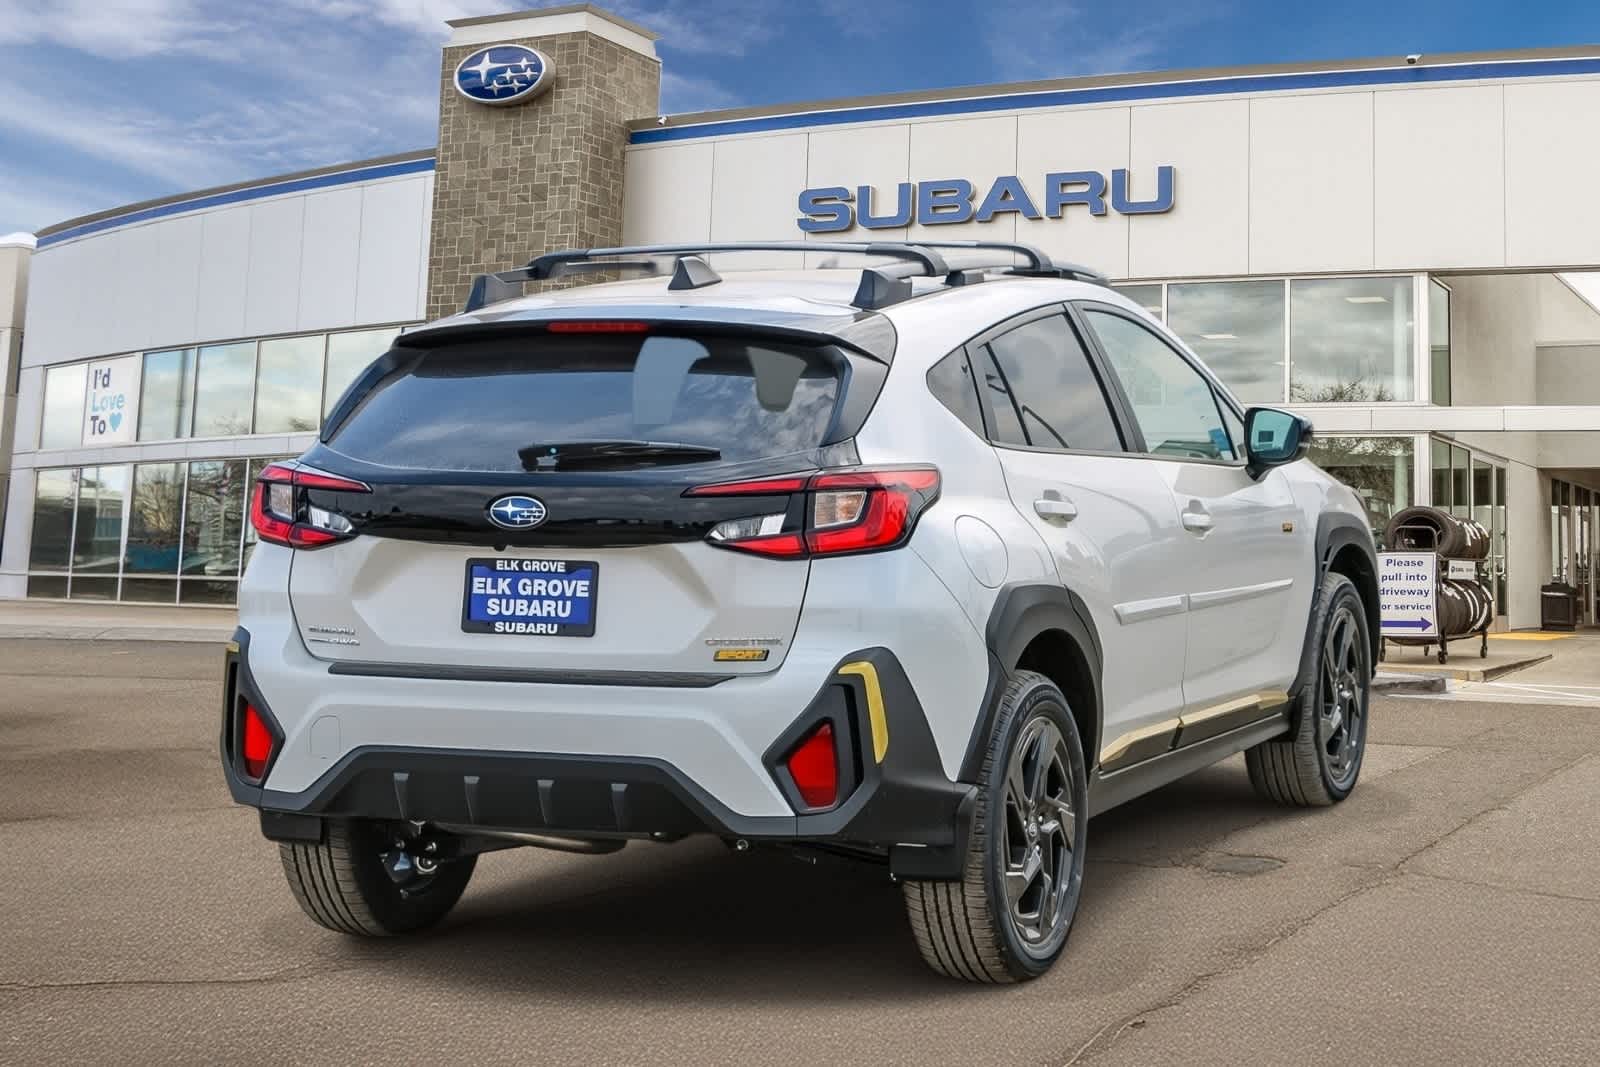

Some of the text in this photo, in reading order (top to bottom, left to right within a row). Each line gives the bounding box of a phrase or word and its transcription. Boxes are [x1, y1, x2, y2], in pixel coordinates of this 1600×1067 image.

[797, 165, 1175, 233] SUBARU
[93, 367, 111, 389] I'd
[91, 391, 125, 412] Love
[90, 415, 106, 435] To
[496, 560, 566, 572] ELK GROVE
[1386, 558, 1424, 567] Please
[1381, 572, 1428, 583] pull into
[472, 577, 590, 597] ELK GROVE
[1379, 586, 1430, 598] driveway
[486, 598, 572, 618] SUBARU
[1394, 602, 1432, 610] service
[494, 622, 558, 634] SUBARU
